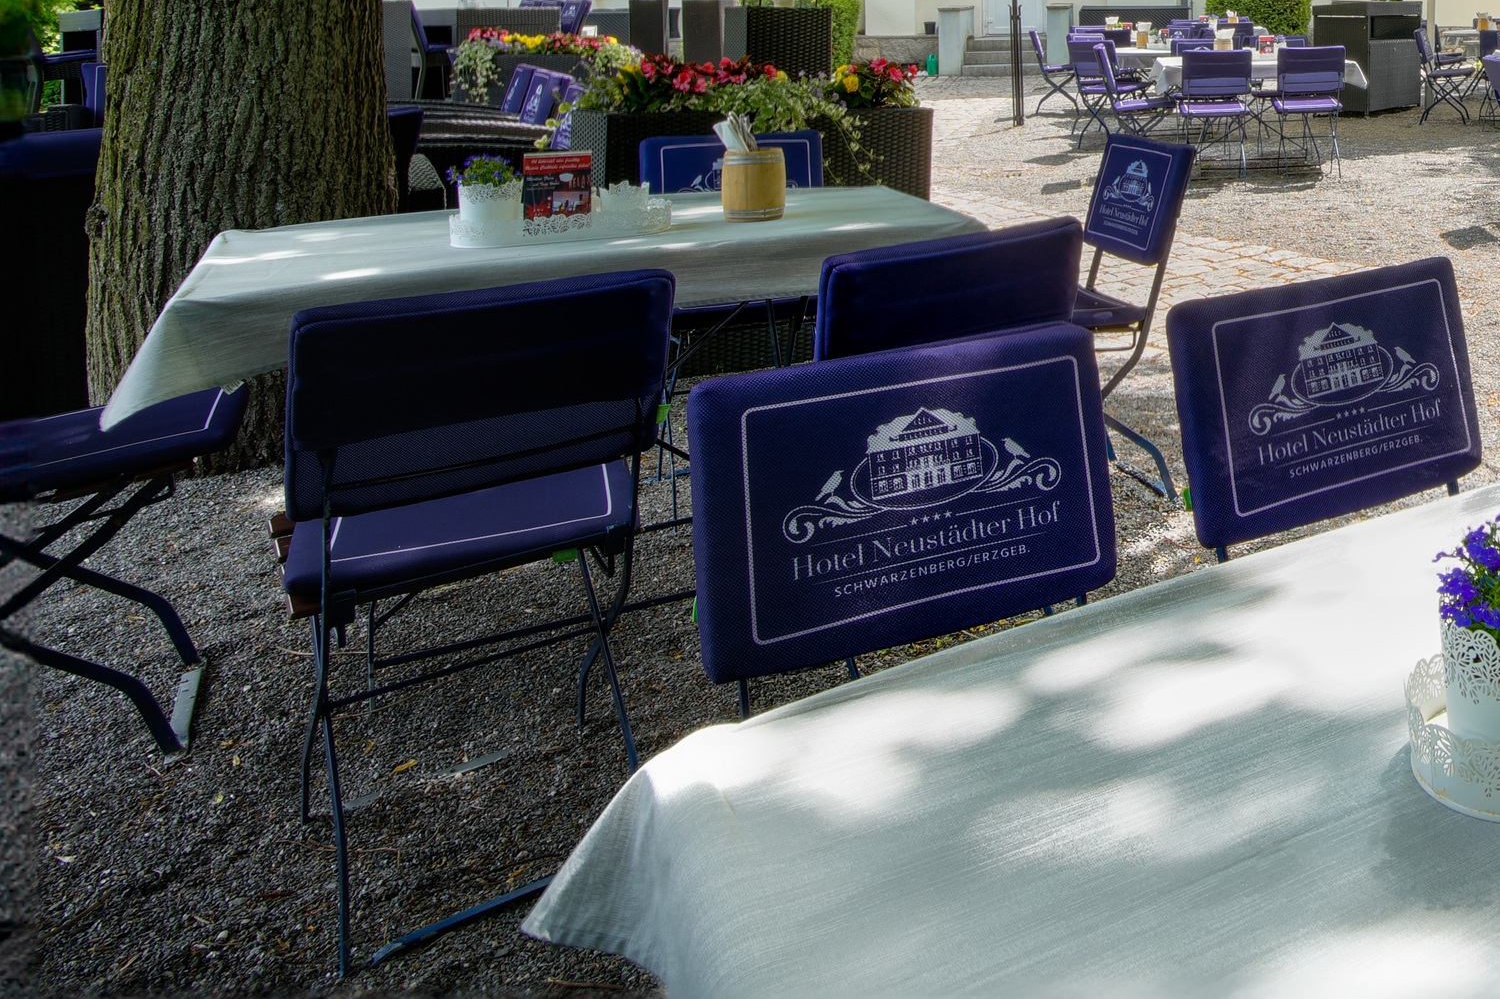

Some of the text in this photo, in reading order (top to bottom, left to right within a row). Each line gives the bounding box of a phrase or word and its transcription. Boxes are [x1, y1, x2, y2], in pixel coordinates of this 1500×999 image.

[1258, 398, 1441, 466] Hotel Neustädter Hof
[1289, 434, 1424, 479] SCHWARZENBERG/ERZGEB.
[792, 500, 1062, 581] Hotel Neustädter Hof
[834, 544, 1032, 598] SCHWARZENBERG/ERZGEB.
